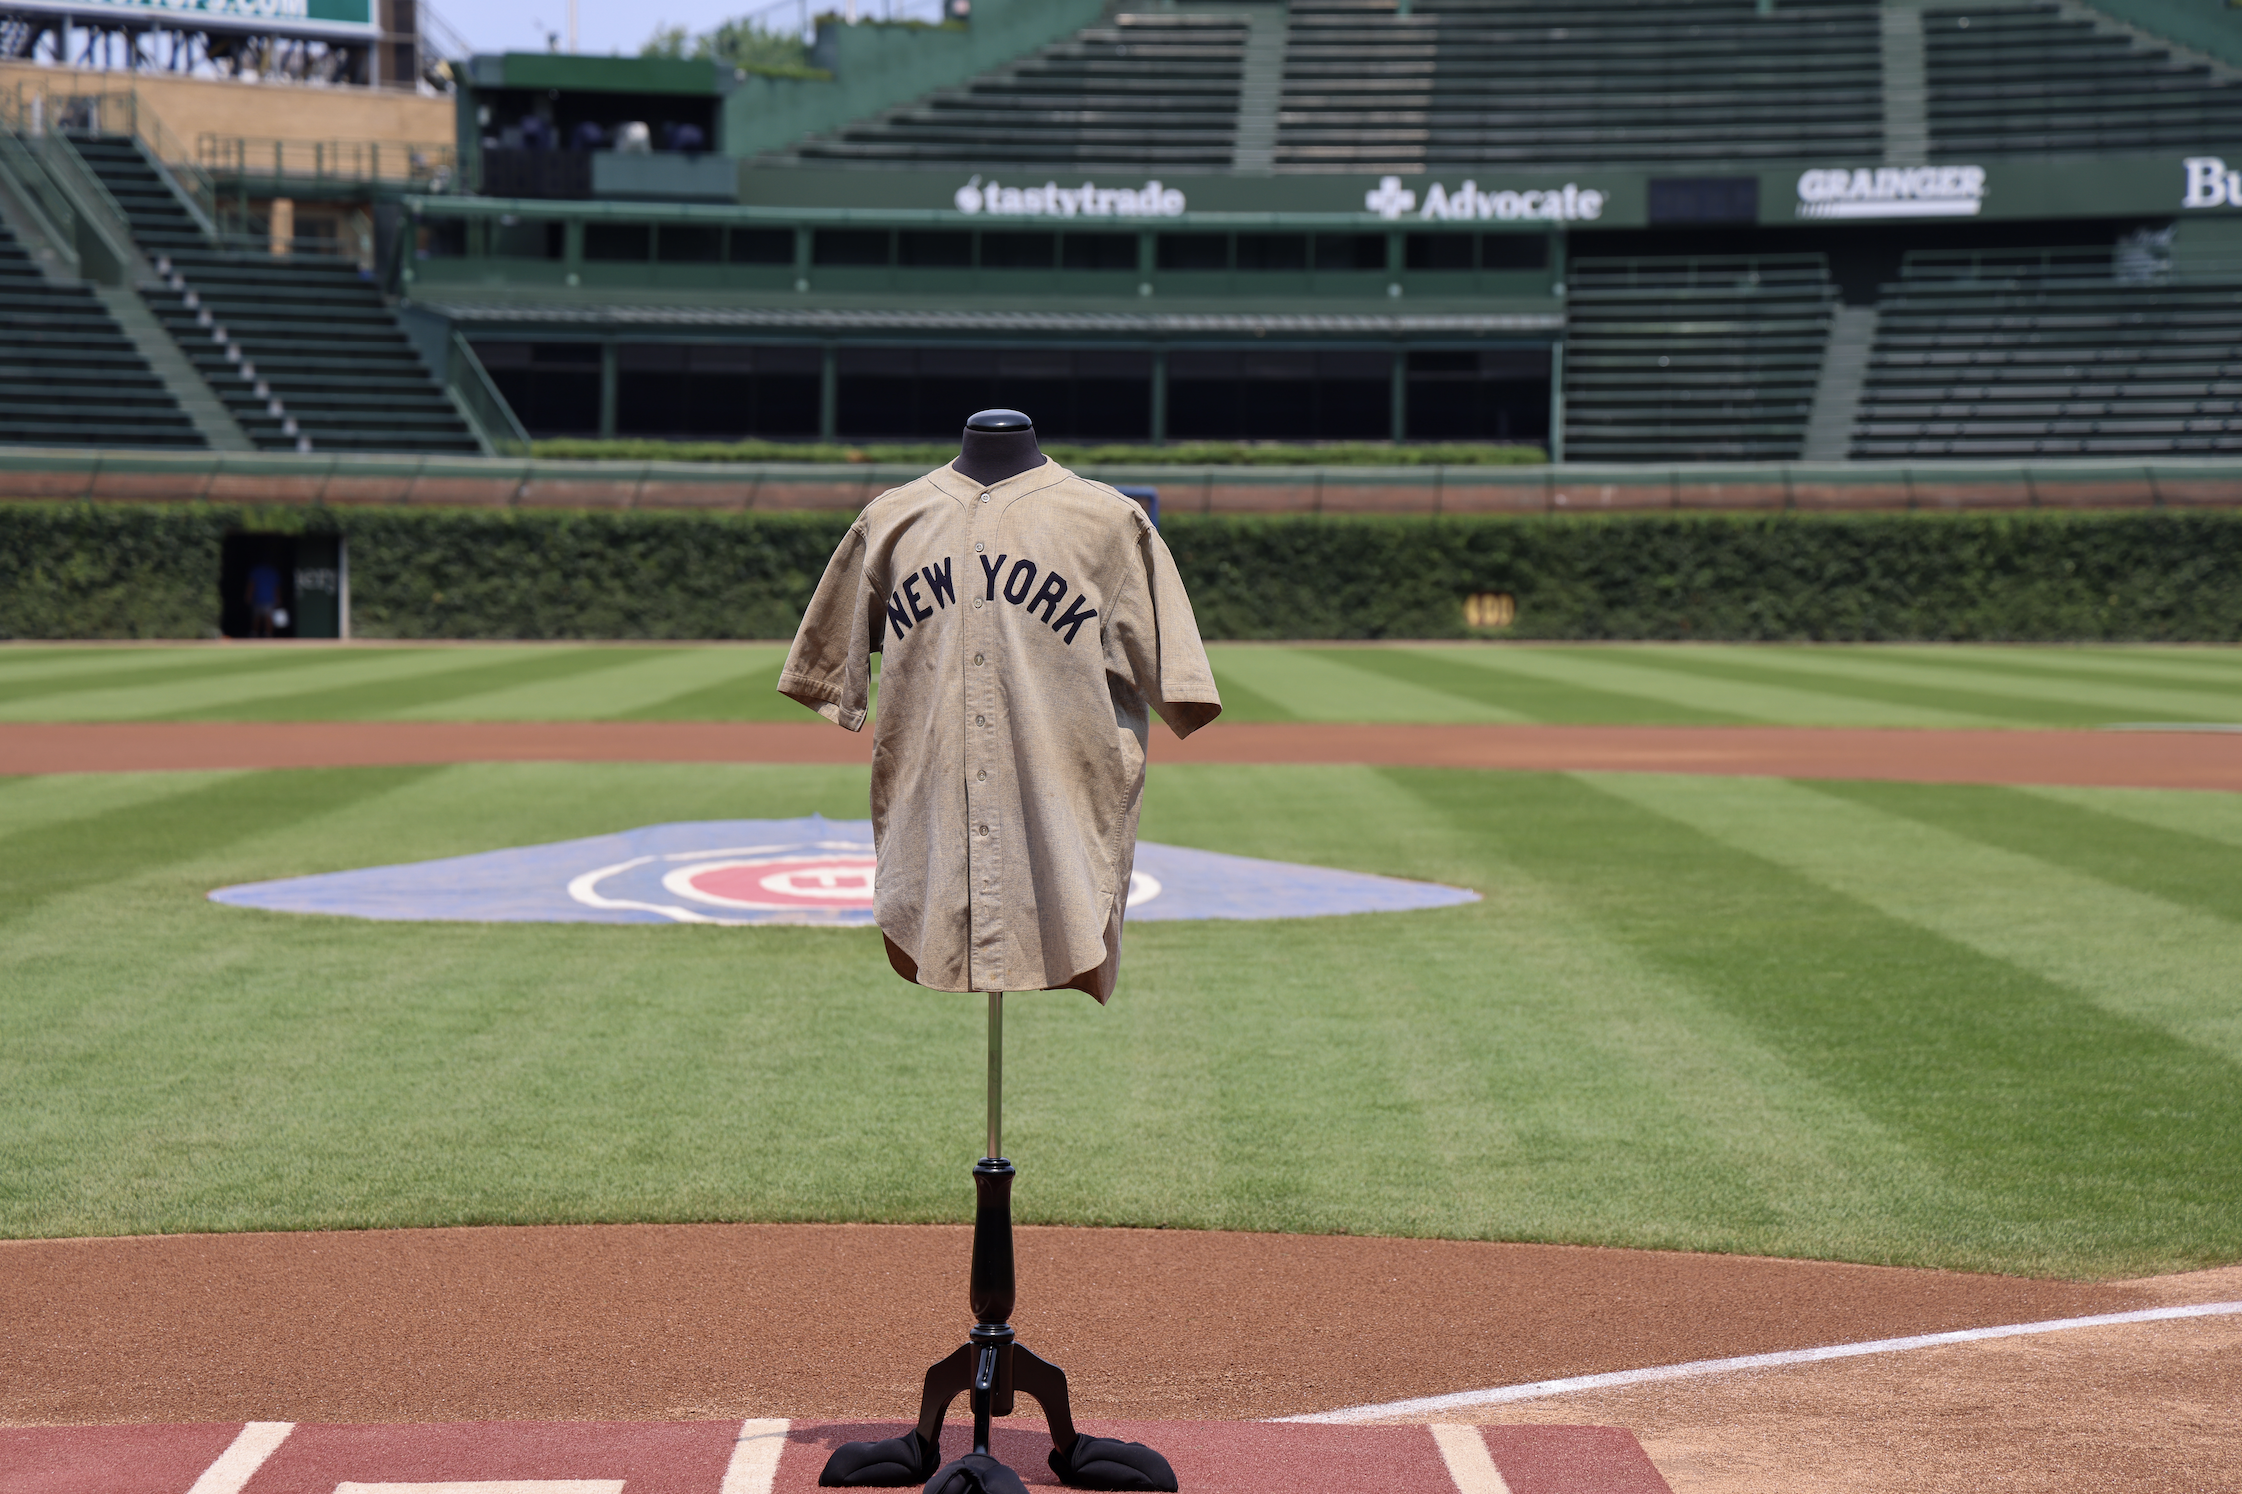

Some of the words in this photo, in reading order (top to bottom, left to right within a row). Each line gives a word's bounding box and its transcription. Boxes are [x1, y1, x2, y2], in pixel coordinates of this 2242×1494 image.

[983, 180, 1187, 218] tastytrade
[1420, 179, 1604, 220] Advocate
[1797, 165, 1986, 202] GRAINGER
[887, 556, 956, 640] NEW
[979, 554, 1098, 645] YORK
